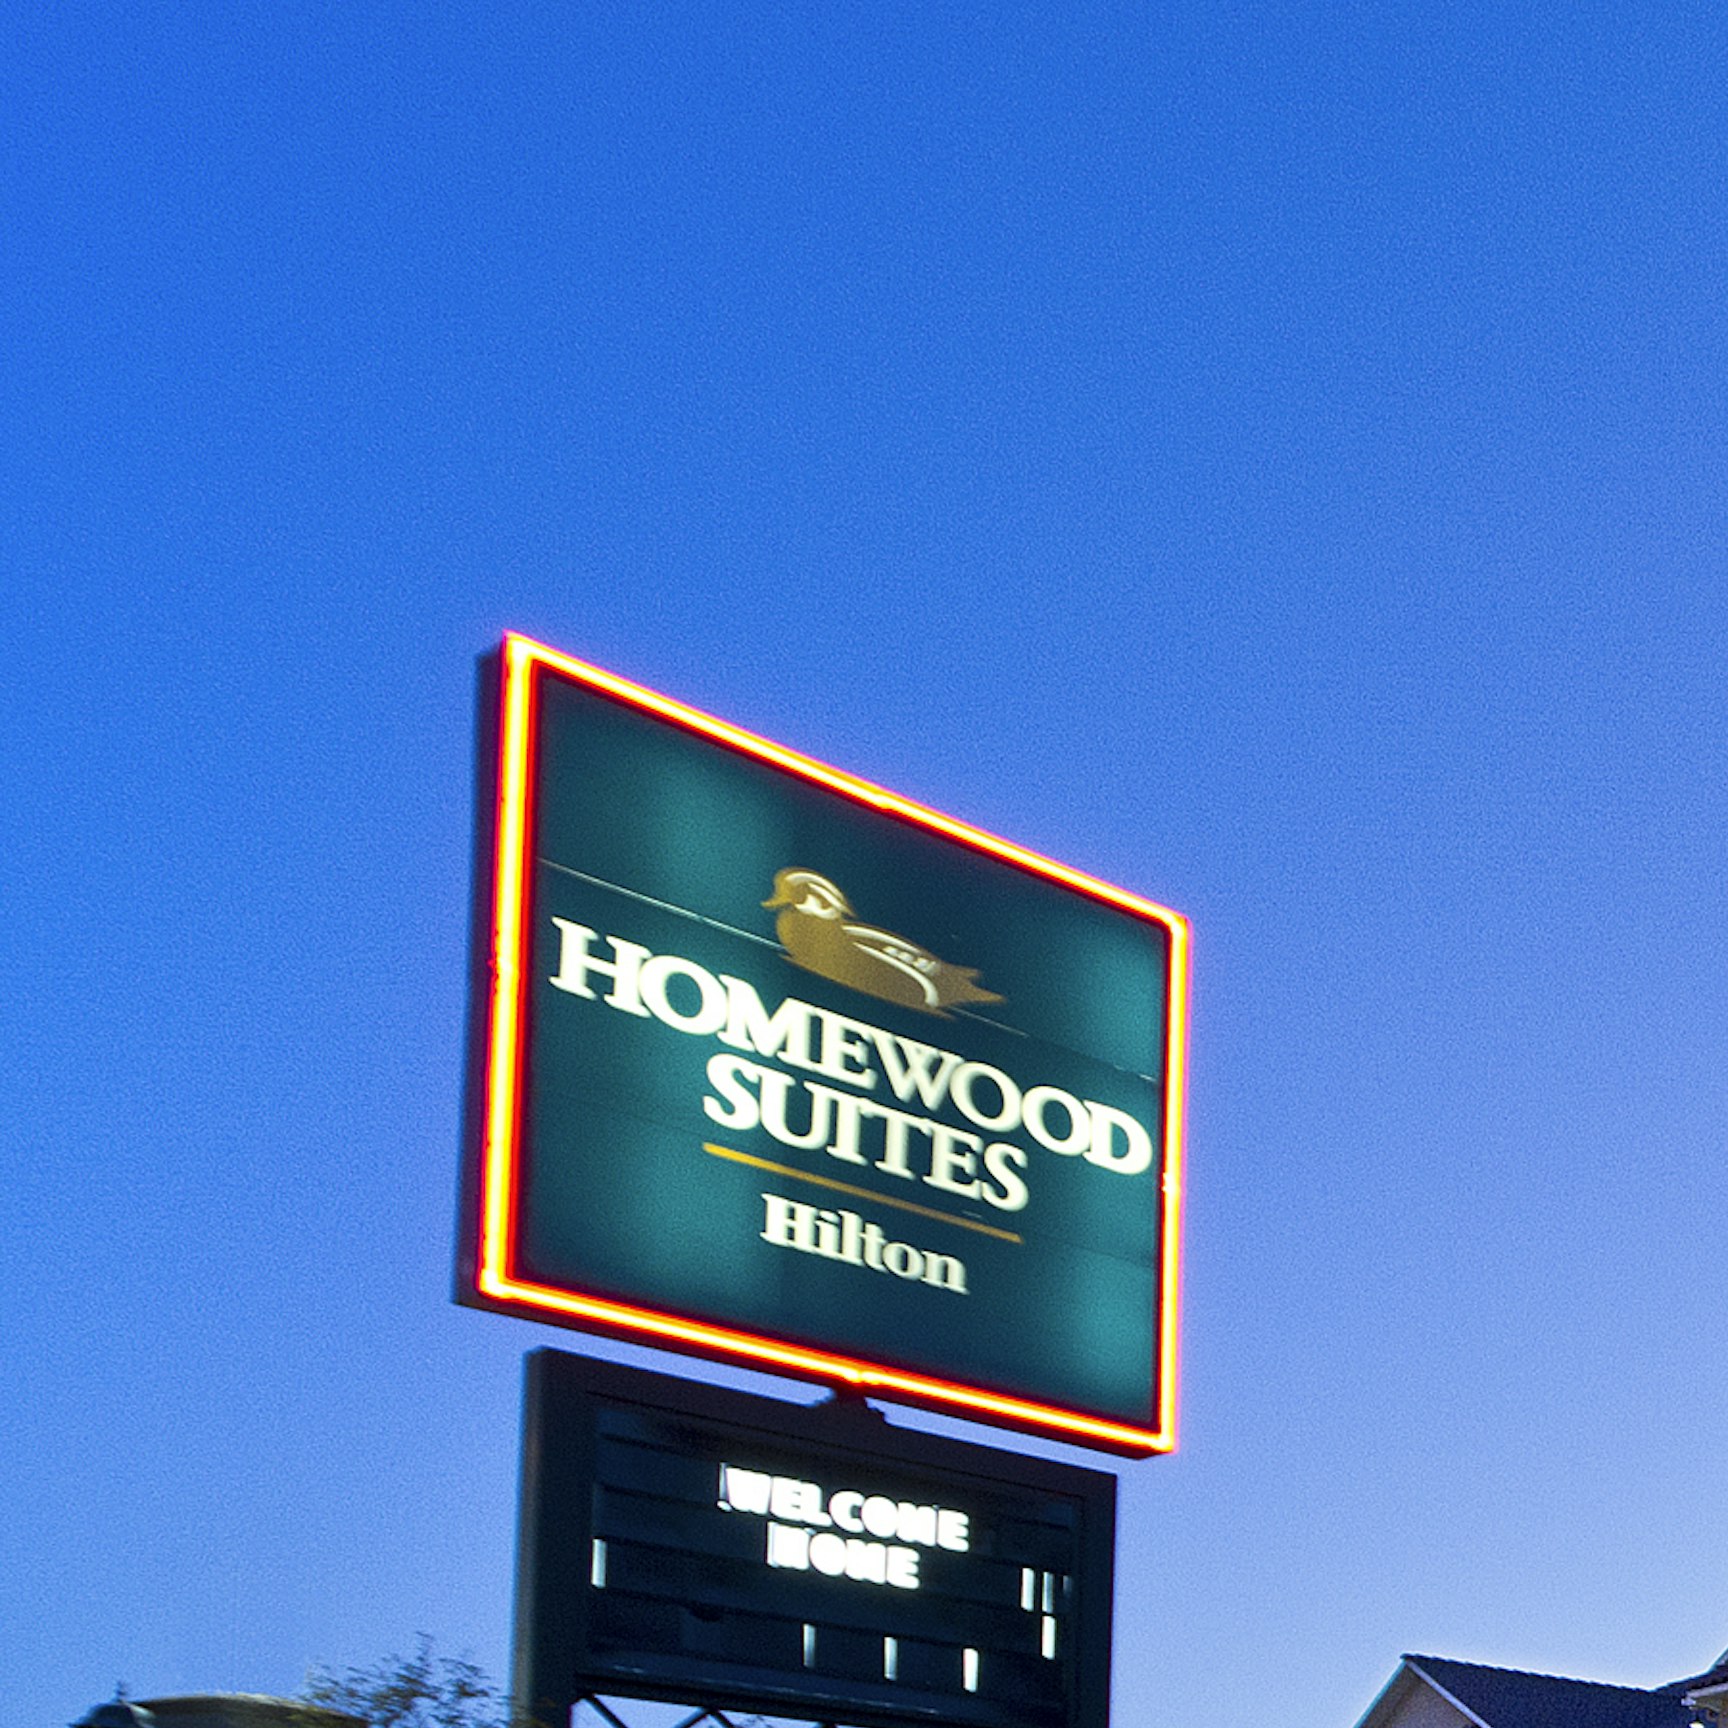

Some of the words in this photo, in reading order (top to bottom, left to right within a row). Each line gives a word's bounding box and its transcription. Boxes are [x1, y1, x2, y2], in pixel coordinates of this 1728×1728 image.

[550, 917, 1153, 1175] HOMEWOOD
[703, 1053, 1030, 1212] SUITES
[761, 1193, 968, 1295] Hilton
[720, 1465, 969, 1552] WELCOME
[766, 1520, 920, 1589] HOME
